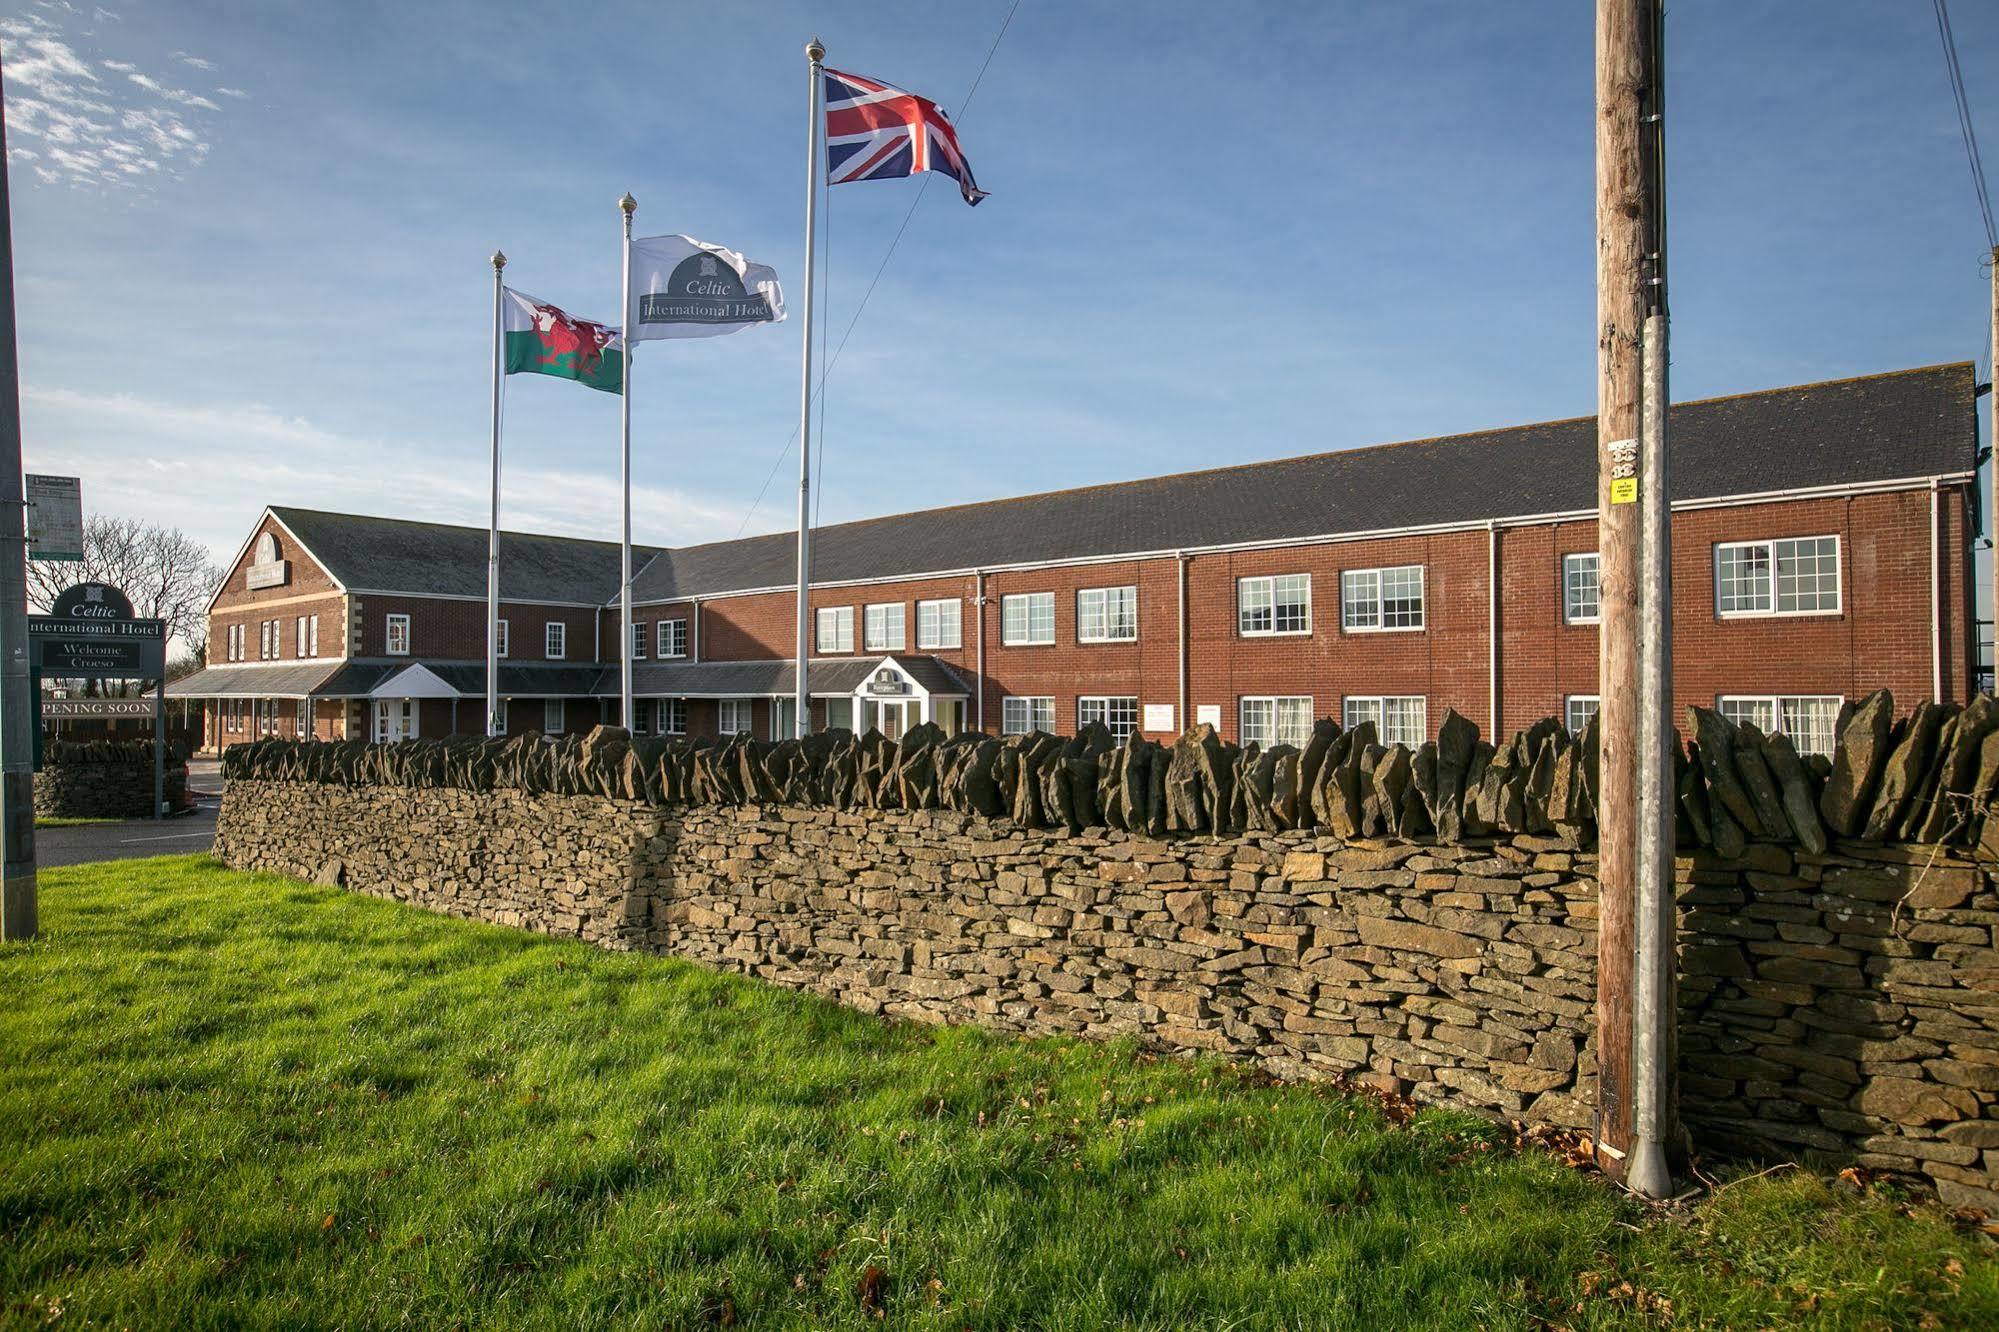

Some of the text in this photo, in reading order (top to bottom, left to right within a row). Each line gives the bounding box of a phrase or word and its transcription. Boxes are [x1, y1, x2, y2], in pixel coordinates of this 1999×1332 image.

[685, 280, 731, 295] Celtic
[644, 302, 769, 316] International Hotel
[71, 604, 117, 618] Celtic
[30, 622, 160, 636] nternational Hotel
[64, 643, 121, 655] Welcome
[71, 658, 114, 668] Croeso
[42, 703, 151, 714] PENING SOON
